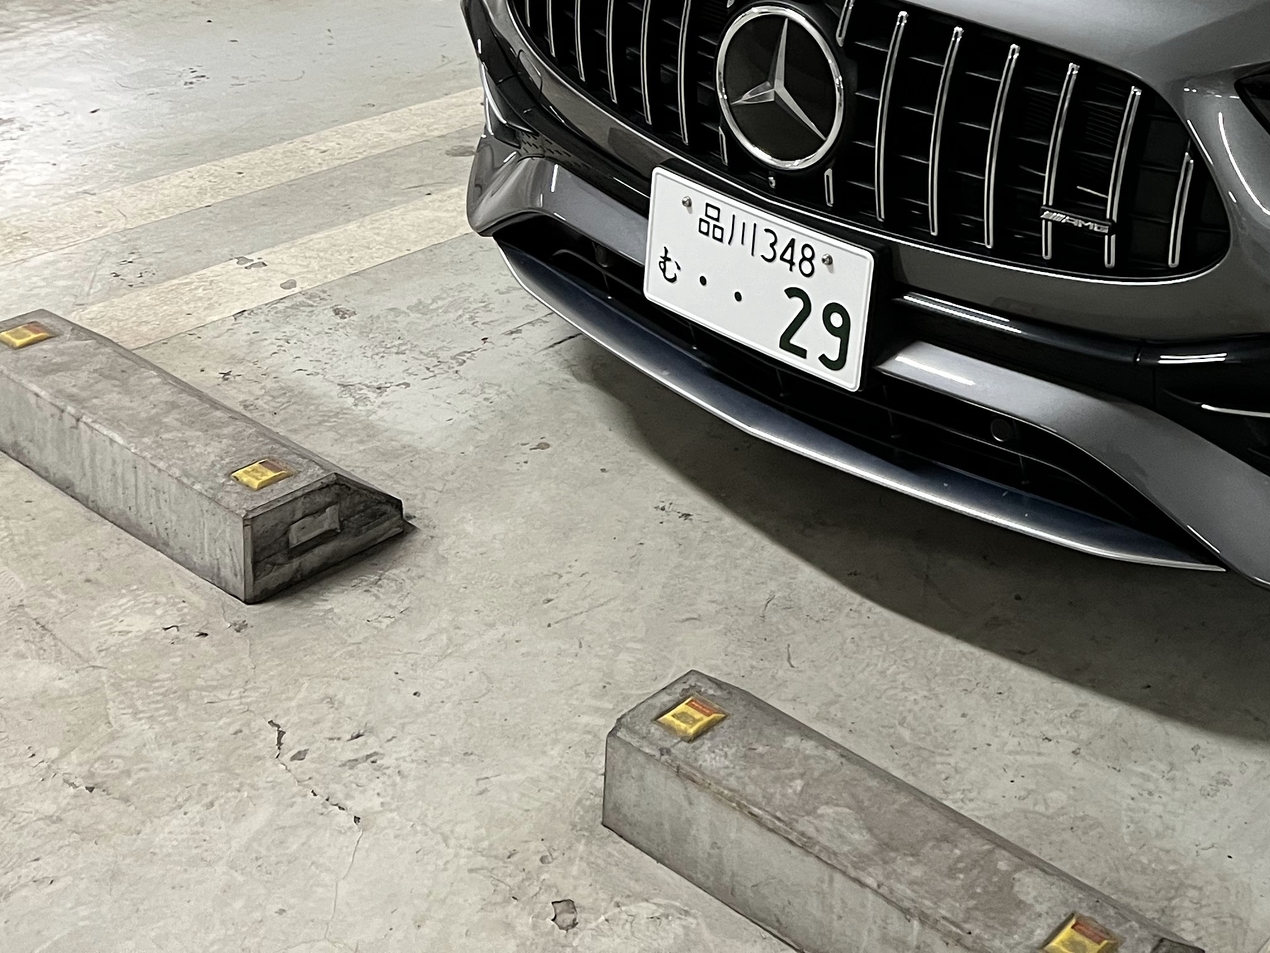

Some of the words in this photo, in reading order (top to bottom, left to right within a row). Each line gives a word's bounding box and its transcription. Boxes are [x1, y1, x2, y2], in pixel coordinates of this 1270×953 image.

[1061, 215, 1109, 234] AMG
[658, 246, 681, 284] む
[779, 286, 851, 371] 29
